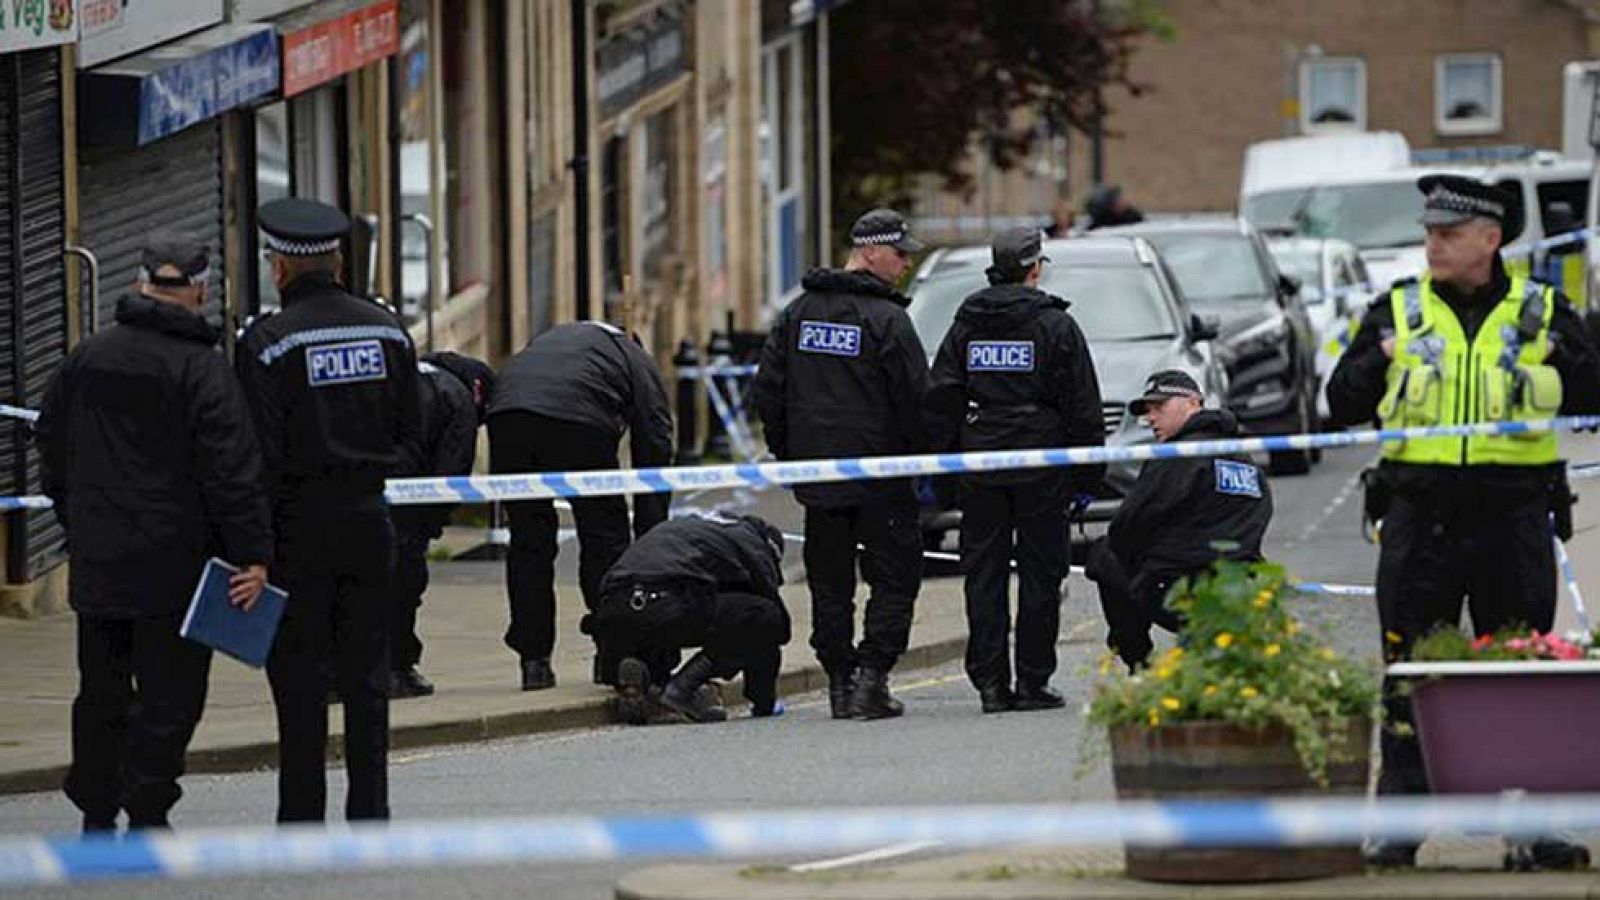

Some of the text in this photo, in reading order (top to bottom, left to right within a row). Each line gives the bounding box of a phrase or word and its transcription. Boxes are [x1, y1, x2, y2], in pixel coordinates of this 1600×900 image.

[801, 327, 856, 350] POLICE
[312, 347, 381, 378] POLICE
[970, 346, 1030, 366] POLICE
